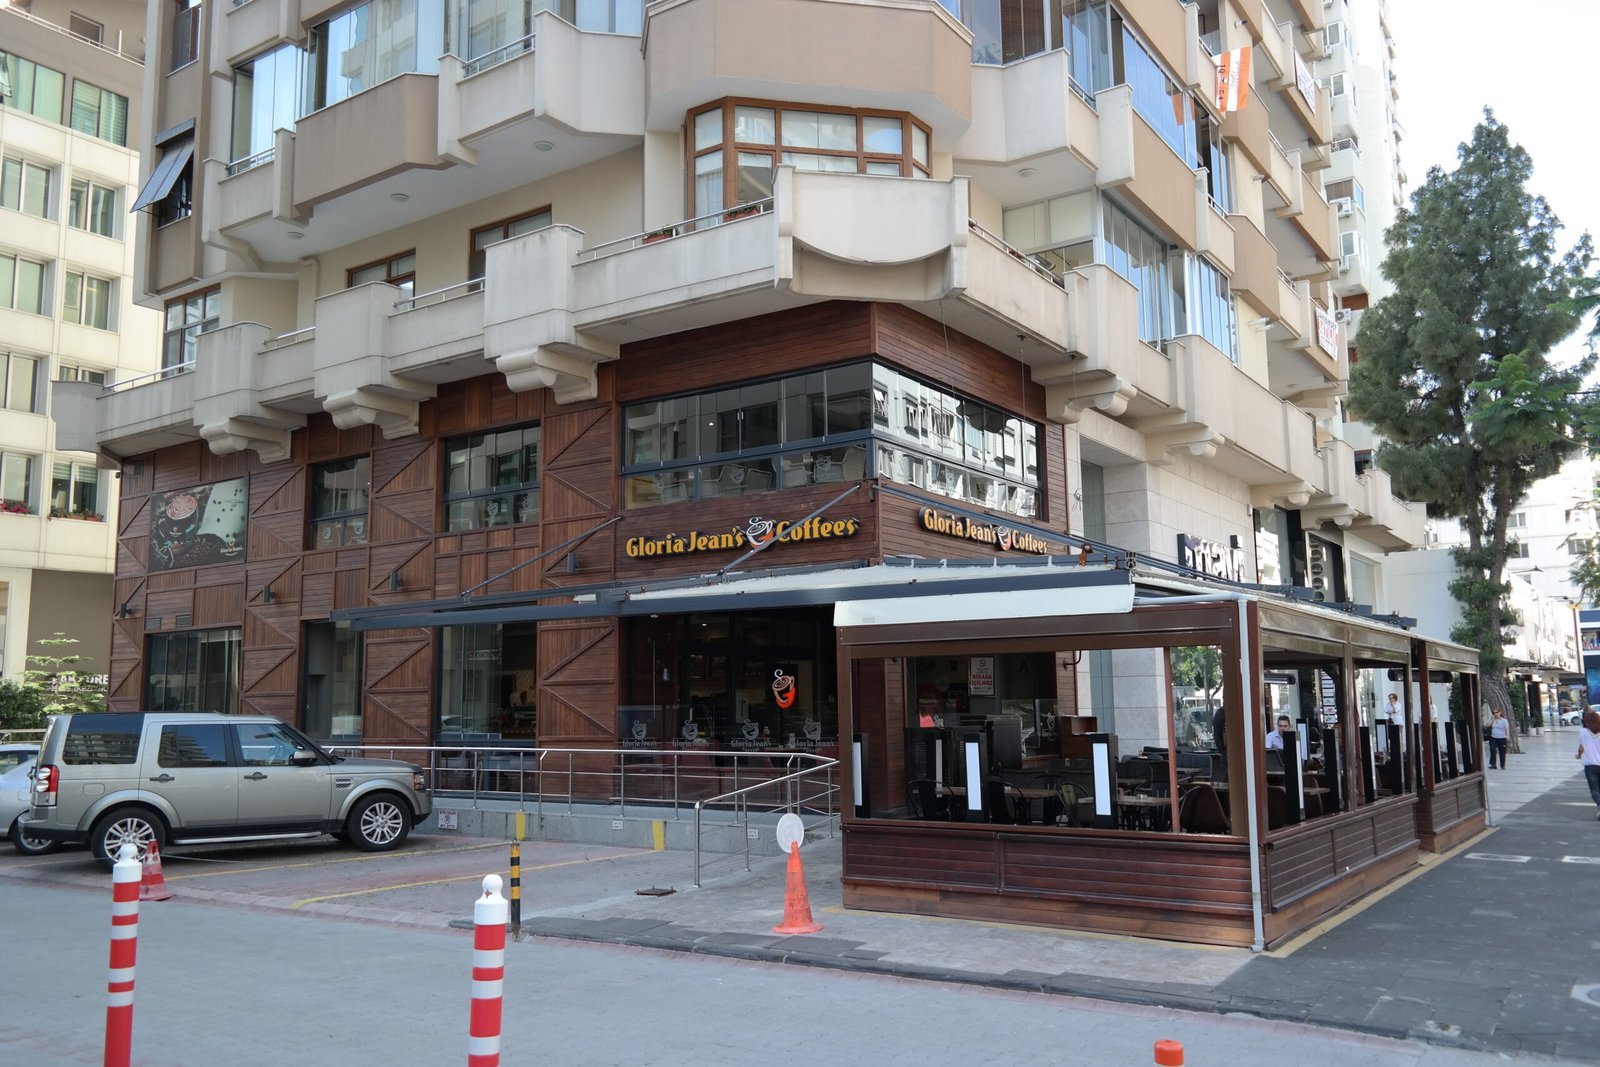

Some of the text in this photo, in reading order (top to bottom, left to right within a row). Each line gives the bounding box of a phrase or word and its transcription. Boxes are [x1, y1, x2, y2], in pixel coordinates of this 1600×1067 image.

[626, 517, 856, 557] Gloria Jean's Coffees
[924, 508, 1048, 554] Gloria Jean's Coffees
[731, 739, 752, 748] Gloria
